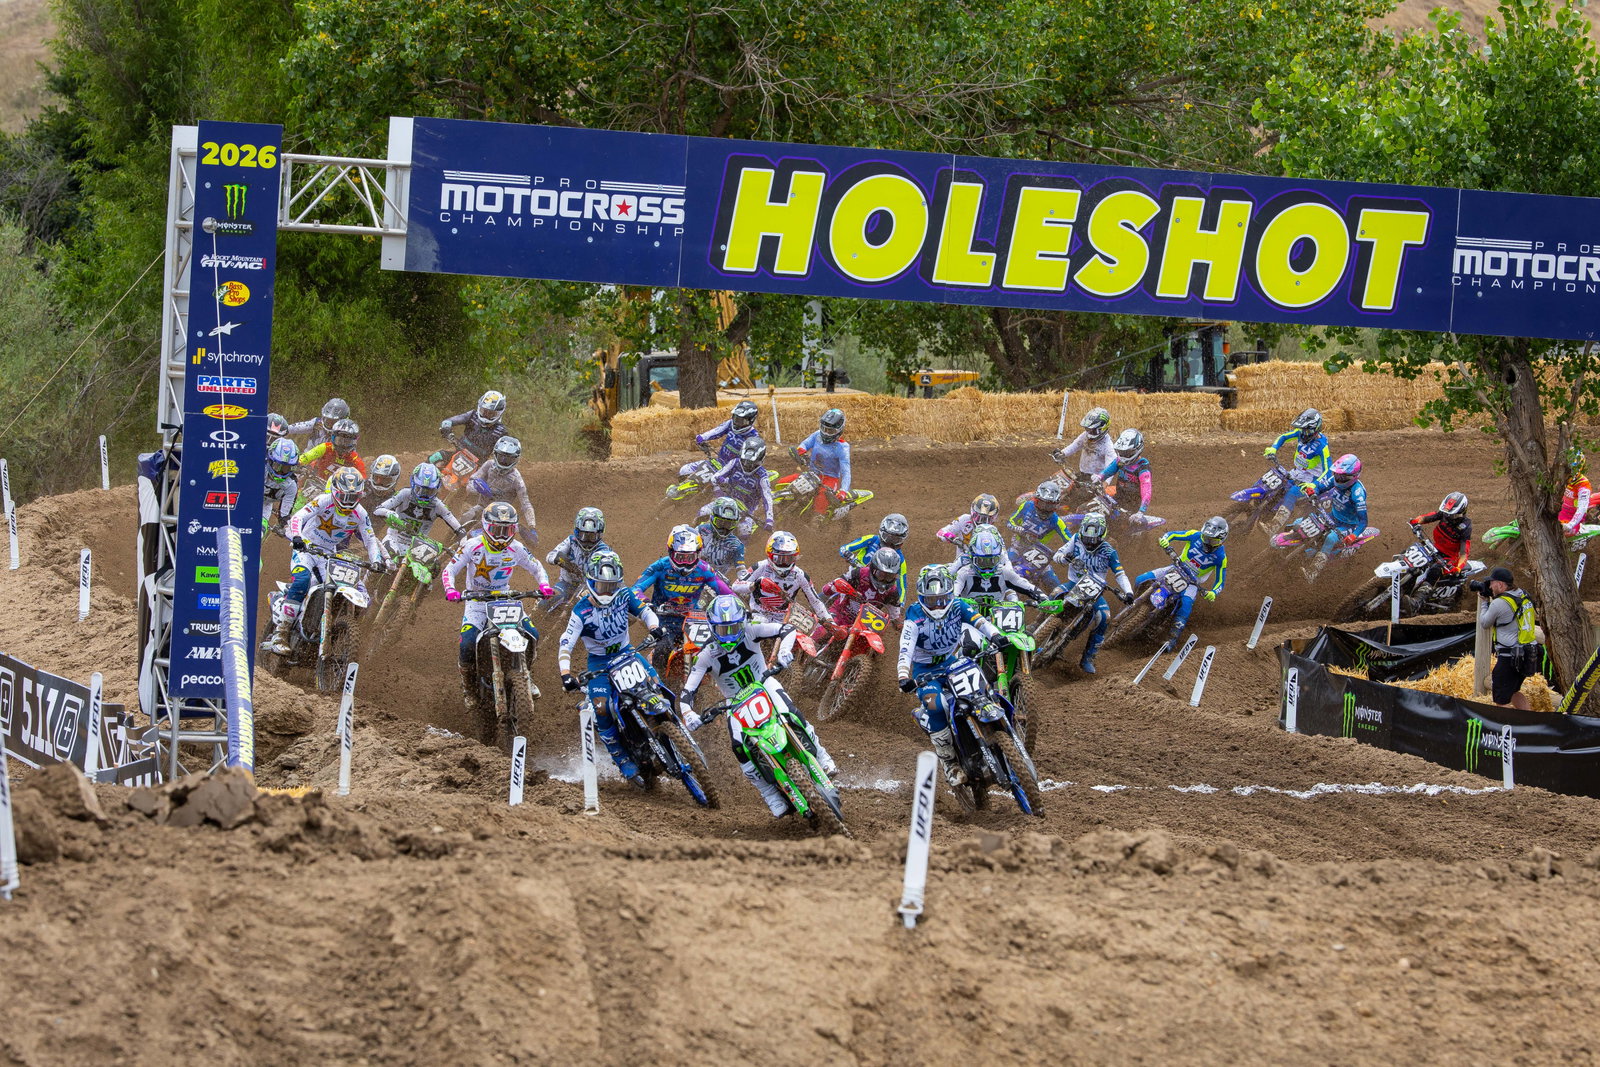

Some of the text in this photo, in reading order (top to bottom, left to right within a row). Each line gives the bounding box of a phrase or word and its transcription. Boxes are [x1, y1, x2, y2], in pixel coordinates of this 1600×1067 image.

[202, 142, 277, 169] 2026
[534, 176, 597, 190] PRO
[440, 183, 686, 225] MOTOCROSS
[216, 222, 253, 231] MONSTER
[440, 212, 685, 237] CHAMPIONSHIP
[721, 167, 1430, 310] HOLESHOT
[1534, 241, 1590, 254] PRO
[230, 255, 263, 263] MOUNTAIN
[1452, 248, 1600, 282] MOTOCR
[228, 289, 240, 297] Pro
[229, 282, 243, 290] Bass
[1451, 276, 1596, 294] CHAMPION
[228, 294, 246, 304] Shops
[207, 351, 264, 366] synchrony
[198, 386, 256, 394] UNLIMITED
[199, 376, 256, 388] PARTS
[208, 460, 237, 470] MOTO
[212, 467, 239, 479] TEES
[206, 492, 238, 503] ETS
[1023, 548, 1048, 568] 42
[1405, 545, 1428, 568] 300
[331, 565, 358, 585] 58
[1078, 577, 1100, 597] 25
[492, 606, 522, 623] 59
[860, 611, 886, 632] 30
[994, 611, 1023, 633] 141
[688, 624, 712, 642] 13
[613, 660, 648, 692] 180
[952, 667, 981, 697] 37
[738, 695, 771, 729] 10
[1355, 705, 1383, 724] MONSTER
[513, 760, 521, 786] UFO
[785, 781, 805, 808] DUNLOP
